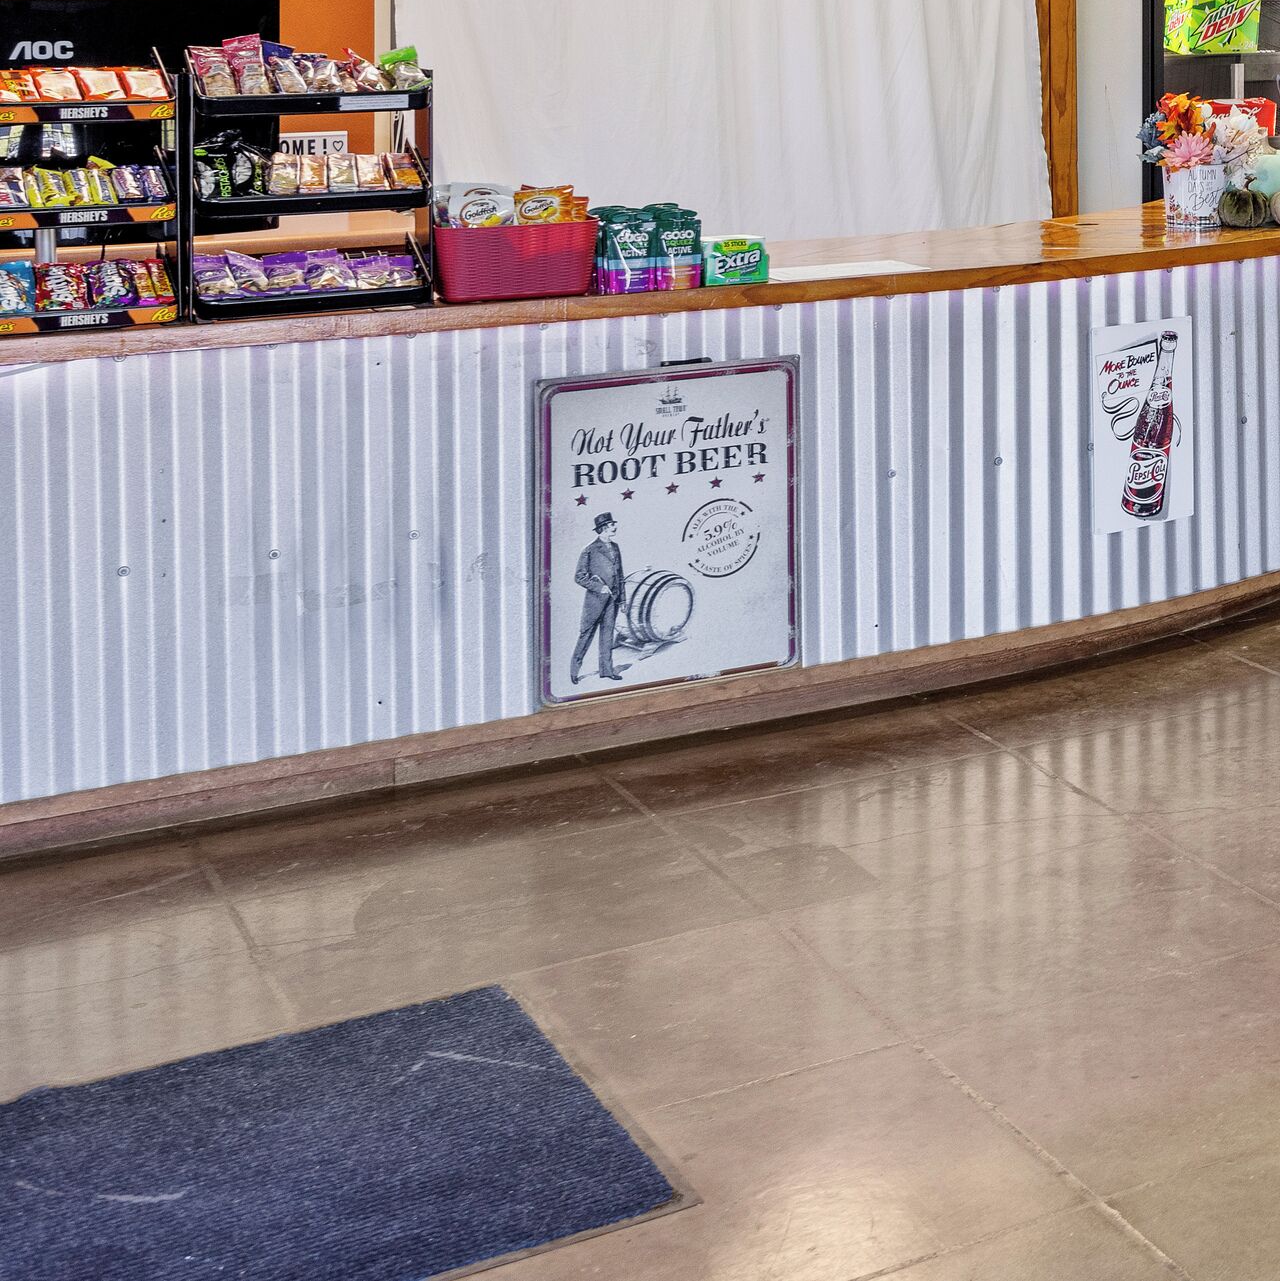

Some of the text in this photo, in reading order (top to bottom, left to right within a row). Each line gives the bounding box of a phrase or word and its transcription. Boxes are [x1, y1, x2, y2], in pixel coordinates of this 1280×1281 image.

[8, 40, 74, 60] AOC
[60, 107, 109, 119] HERSHEY'S
[524, 199, 555, 214] Goldfish
[1189, 186, 1222, 211] Best
[60, 211, 108, 223] HERSHEY'S
[465, 205, 497, 219] Goldfish
[663, 230, 695, 240] GOGO
[665, 238, 695, 246] SQUEEZ
[621, 248, 648, 257] ACTIVE
[667, 246, 692, 254] ACTIVE
[715, 248, 761, 274] Extra
[45, 265, 73, 302] Skittles
[98, 261, 127, 297] Skittles
[61, 314, 109, 327] HERSHEY'S
[1126, 369, 1137, 378] THE
[655, 404, 687, 414] SMALL TOWN
[571, 409, 770, 456] Not Your Father's
[570, 442, 769, 488] ROOT BEER
[692, 504, 738, 530] ALE WITH THE
[704, 519, 737, 541] 5.9%
[697, 528, 744, 553] ALCOHOL BY
[707, 539, 739, 557] VOLUME
[700, 563, 722, 573] TASTE
[734, 543, 751, 564] SPICES
